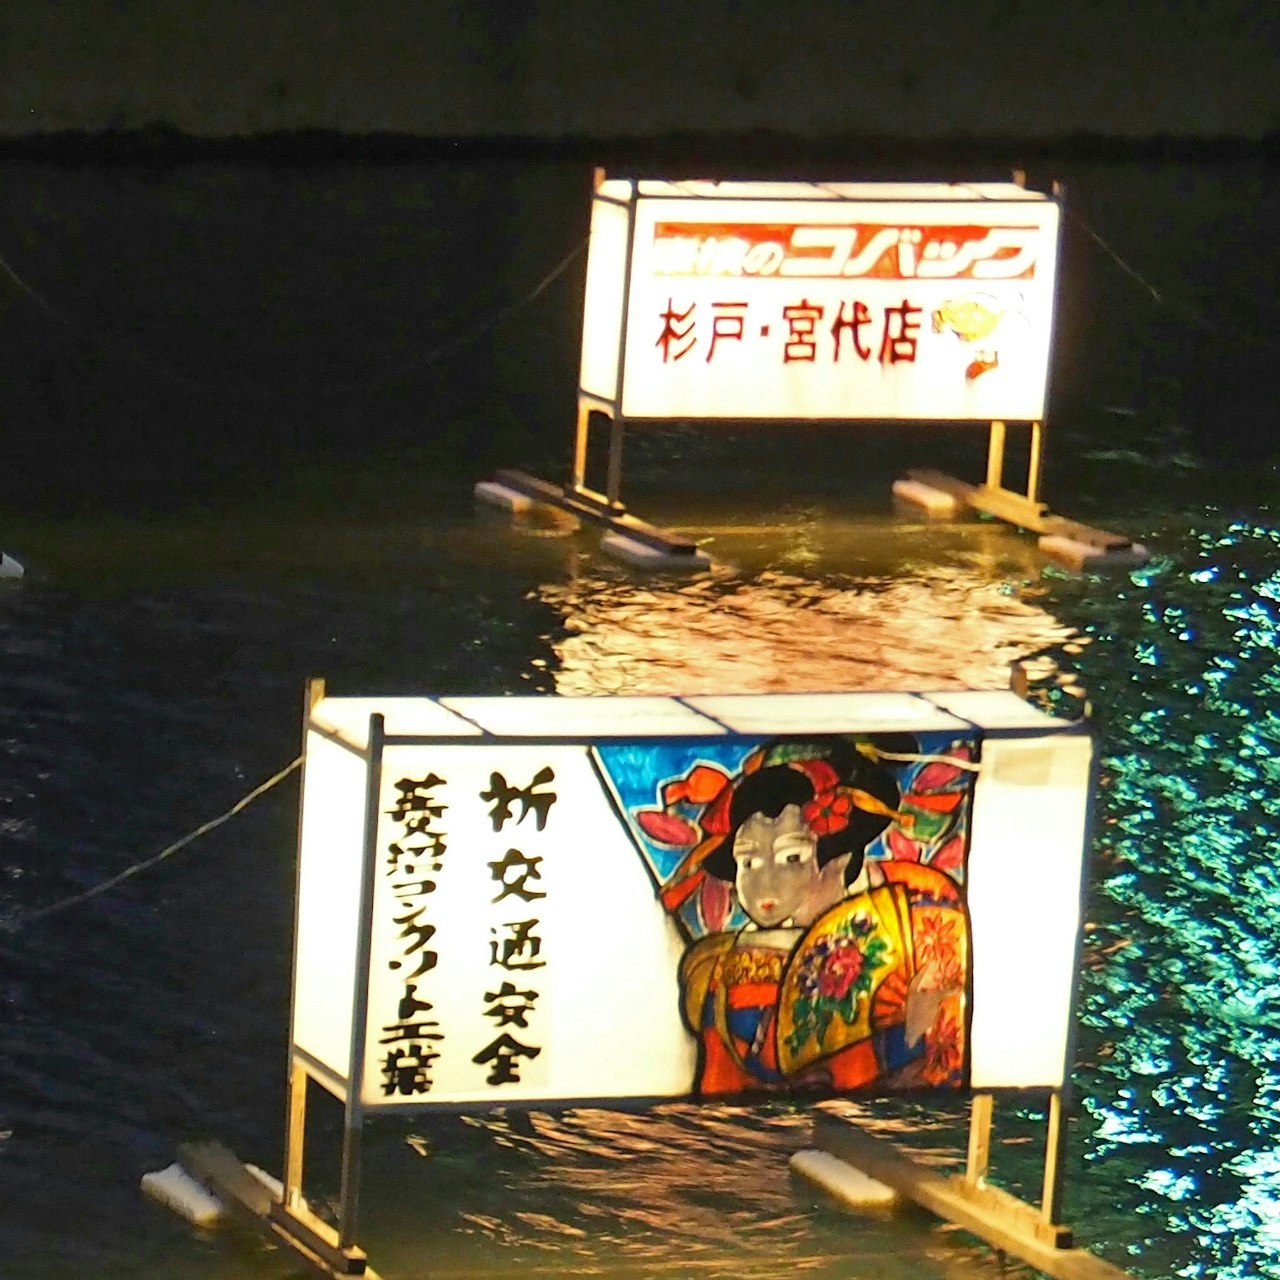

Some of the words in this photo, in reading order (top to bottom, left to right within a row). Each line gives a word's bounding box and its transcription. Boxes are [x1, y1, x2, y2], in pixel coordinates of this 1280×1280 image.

[652, 227, 1038, 278] のコバック
[655, 298, 923, 364] 杉戸・宮代店
[471, 766, 558, 1086] 祈交通安全
